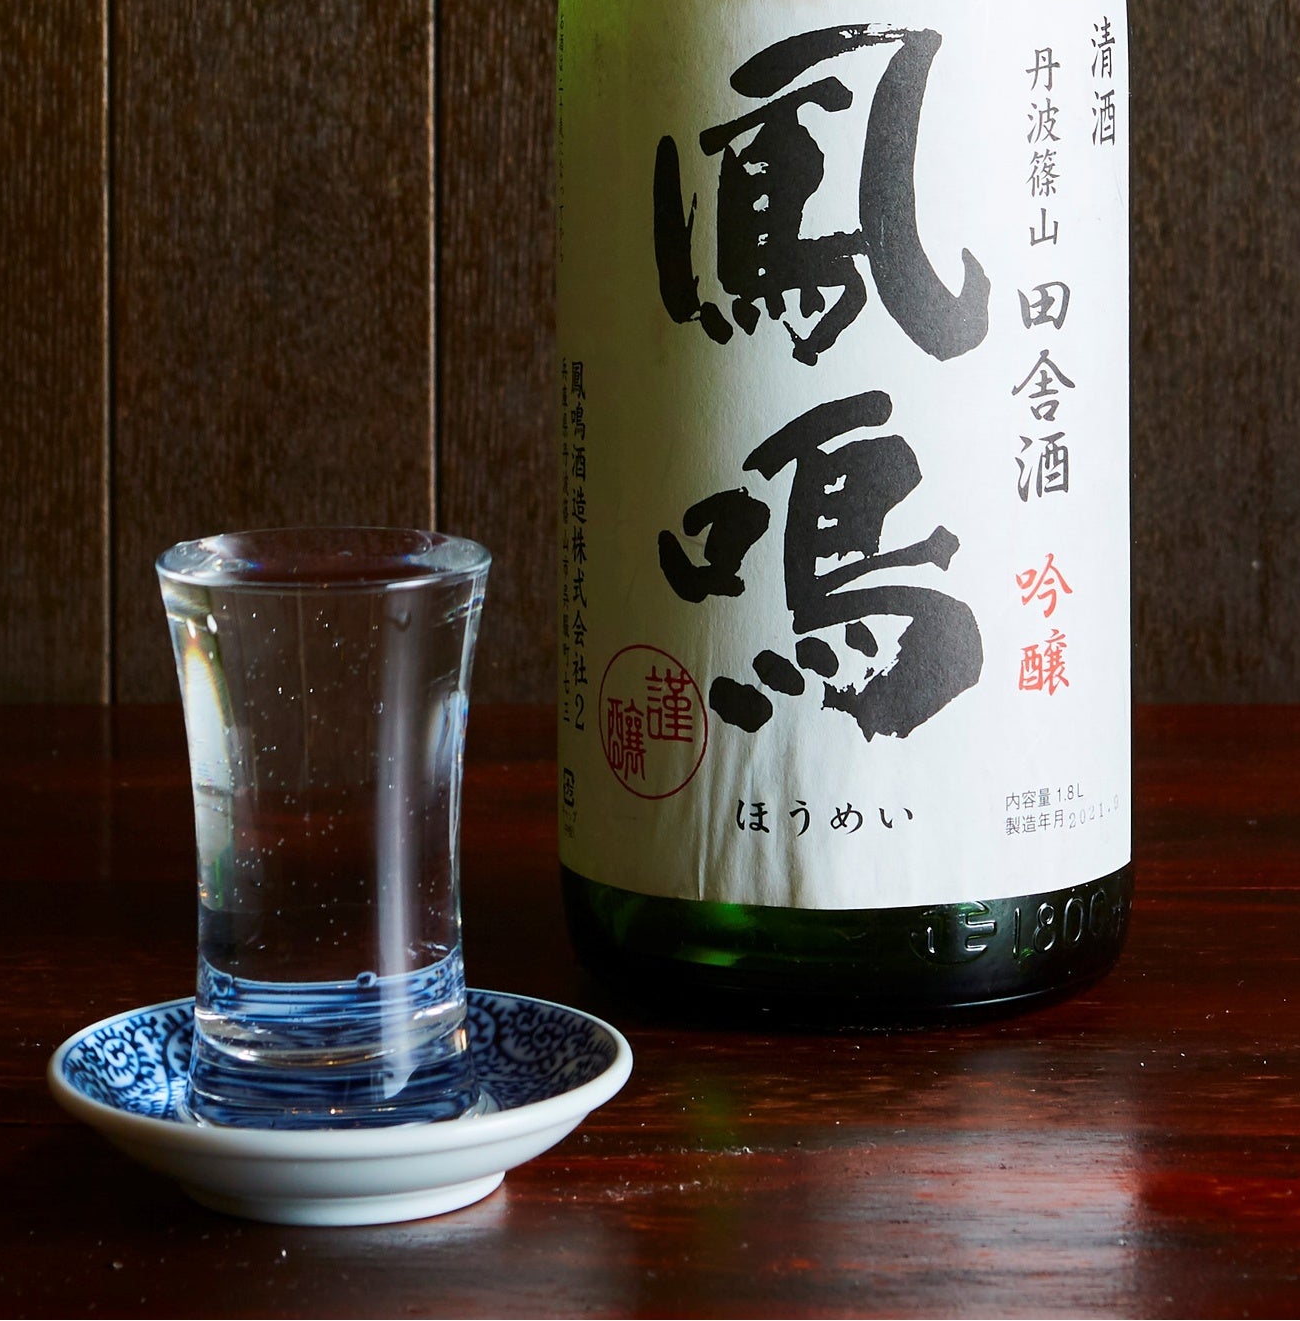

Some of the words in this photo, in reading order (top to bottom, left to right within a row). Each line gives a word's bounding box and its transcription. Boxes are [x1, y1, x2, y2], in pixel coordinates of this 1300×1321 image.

[1025, 46, 1062, 248] 丹波篠山
[1090, 15, 1117, 147] 清酒
[652, 21, 992, 743] 鳳鳴
[1010, 280, 1076, 503] 田舎酒
[1015, 552, 1075, 697] 吟醸
[736, 799, 914, 836] ほうめい
[1005, 787, 1052, 812] 内容量
[1005, 809, 1064, 836] 製造年月
